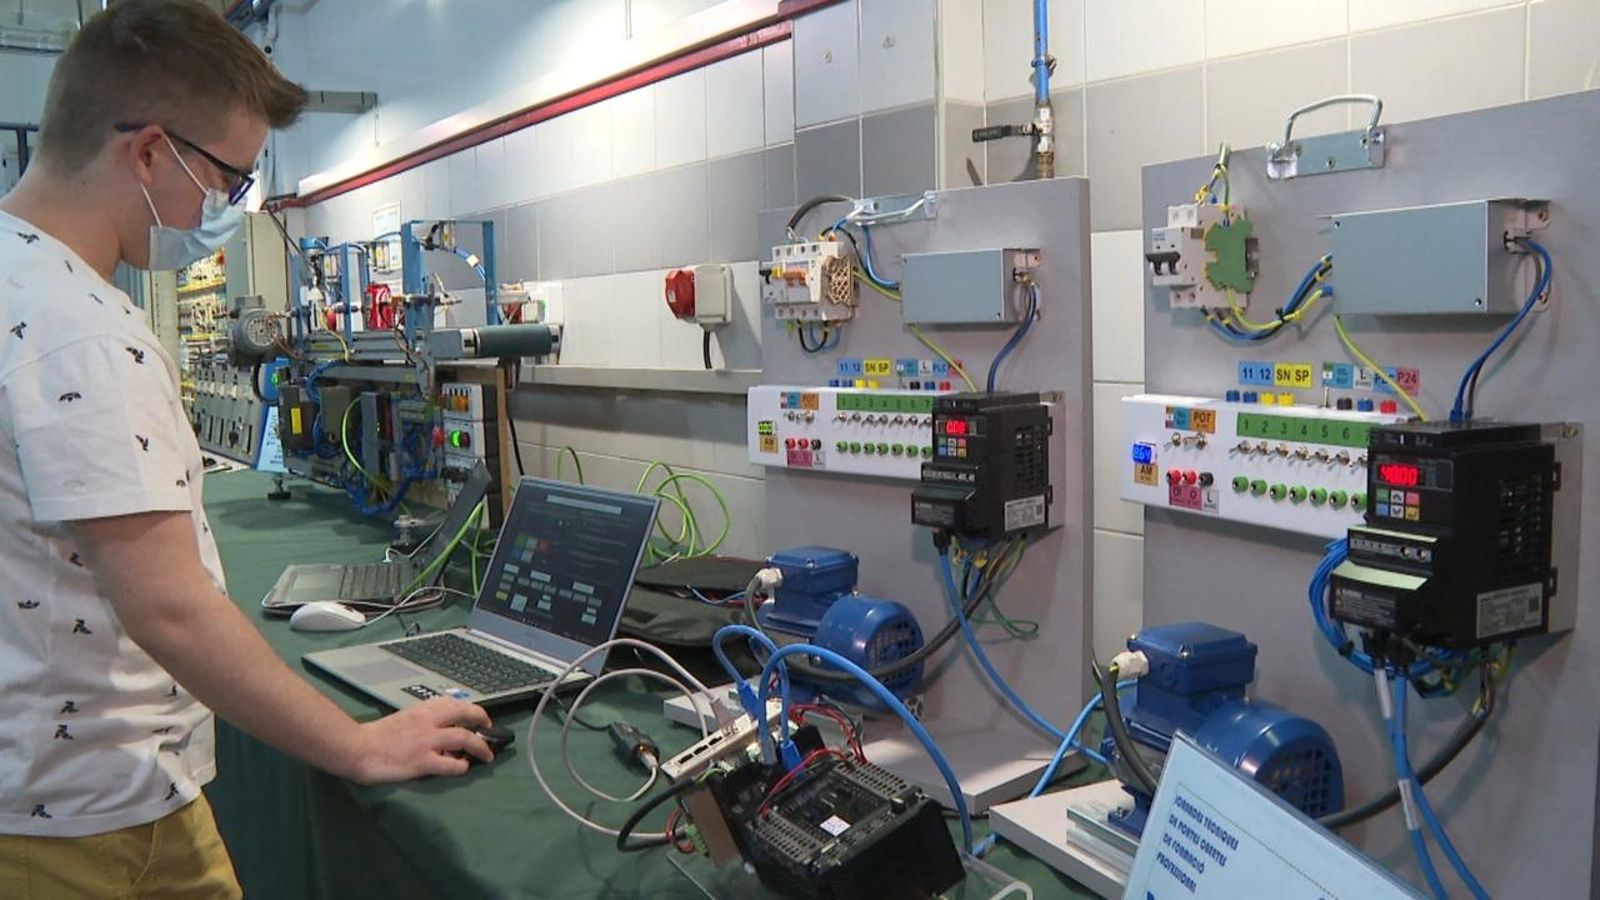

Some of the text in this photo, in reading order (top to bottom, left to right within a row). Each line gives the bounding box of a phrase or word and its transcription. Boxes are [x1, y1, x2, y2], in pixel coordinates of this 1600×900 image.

[1242, 367, 1310, 382] 11 12 SN SP
[1398, 371, 1417, 384] P24
[1193, 411, 1210, 423] POT
[1162, 833, 1172, 847] DE
[1169, 813, 1228, 868] DE PORTES OBERTES
